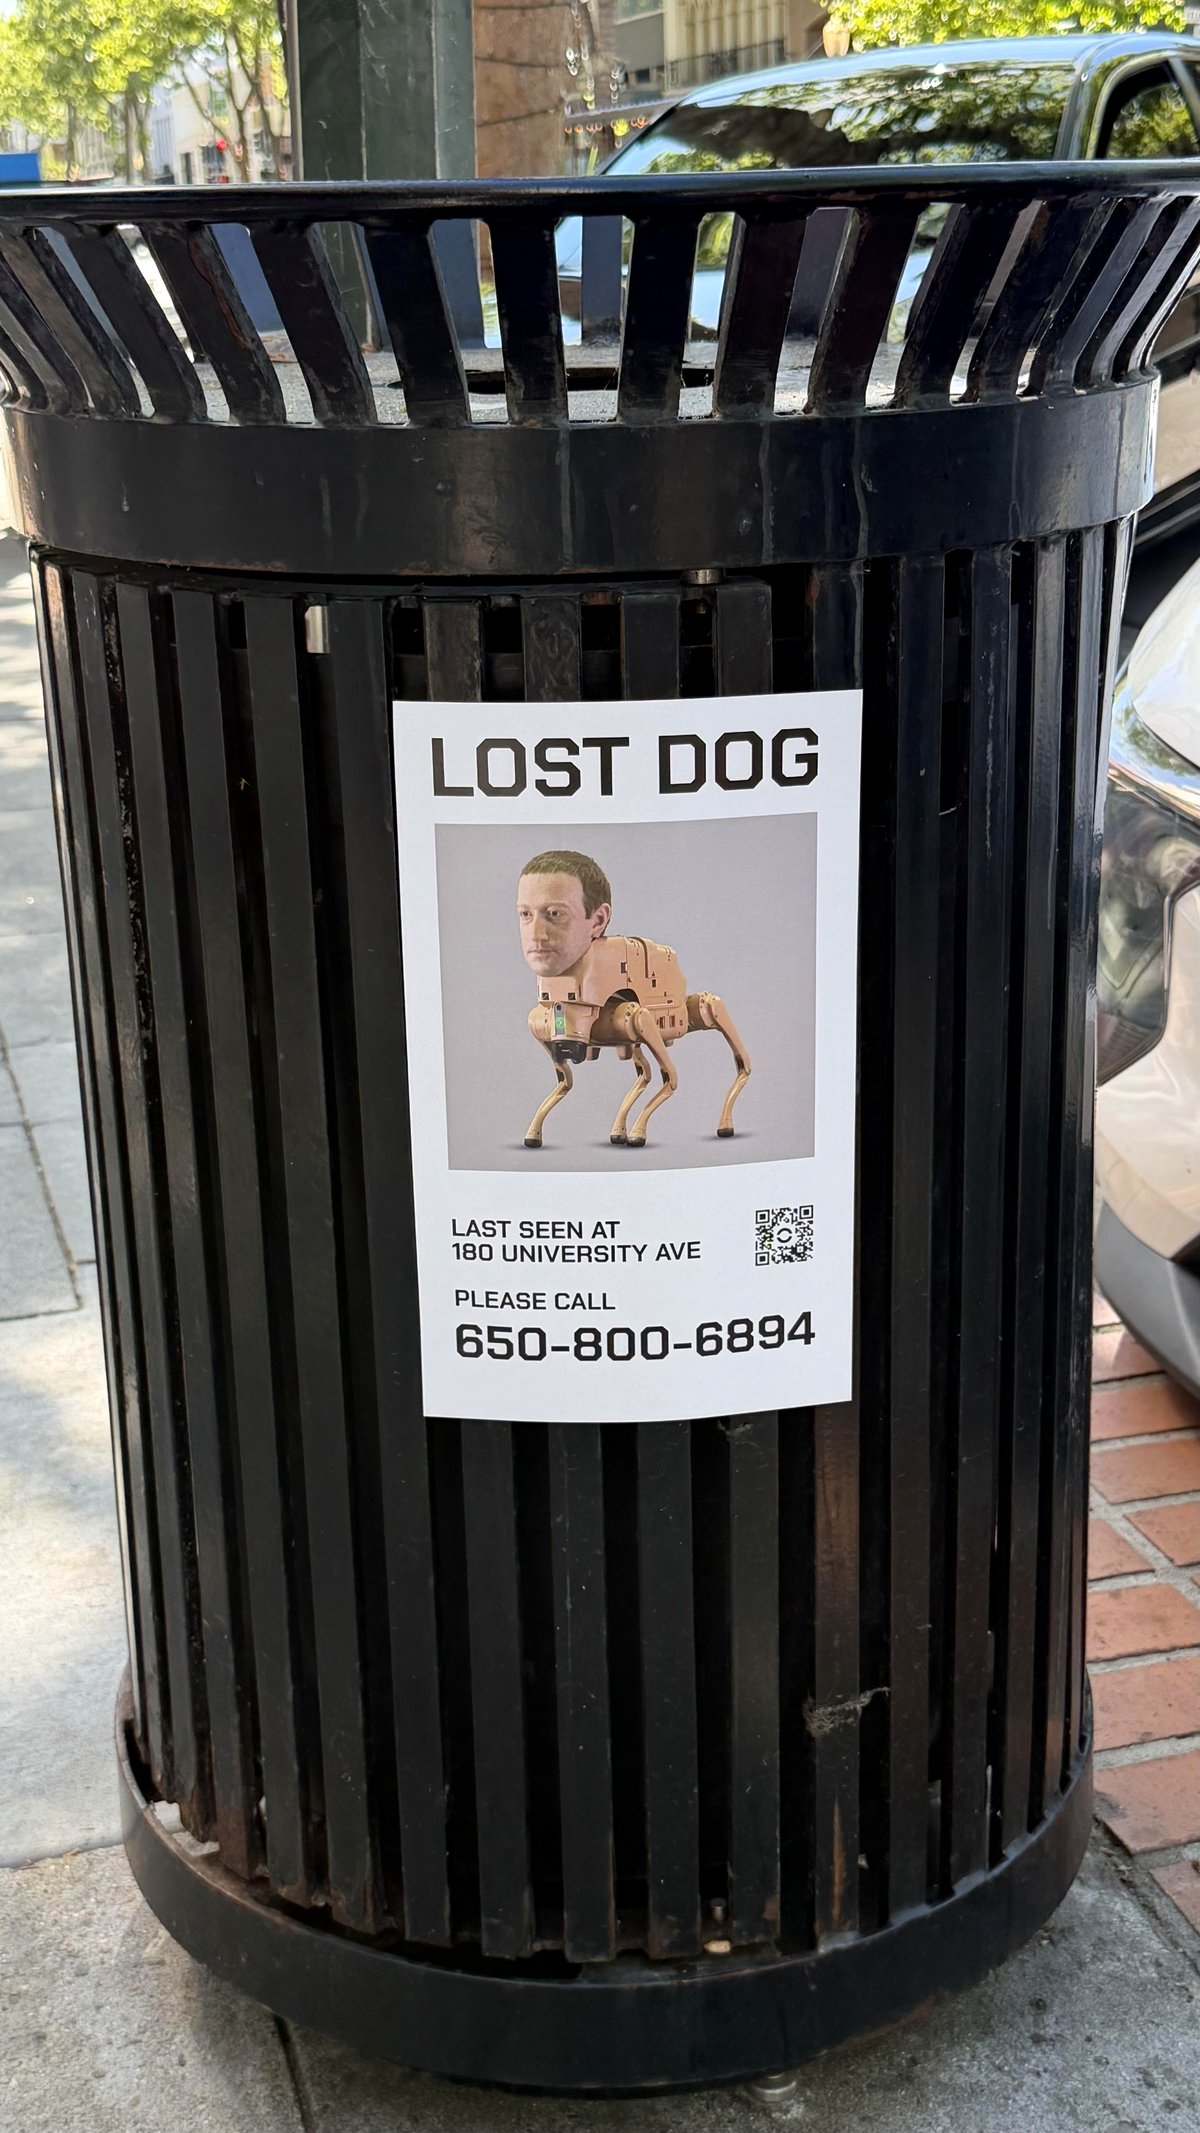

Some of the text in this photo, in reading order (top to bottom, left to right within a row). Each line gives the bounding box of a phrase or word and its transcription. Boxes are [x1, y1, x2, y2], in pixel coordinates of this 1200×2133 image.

[431, 727, 820, 797] LOST DOG
[451, 1218, 621, 1239] LAST SEEN AT
[452, 1240, 701, 1263] 180 UNIVERSITY AVE
[455, 1289, 616, 1310] PLEASE CALL
[455, 1311, 816, 1362] 650-800-6894
